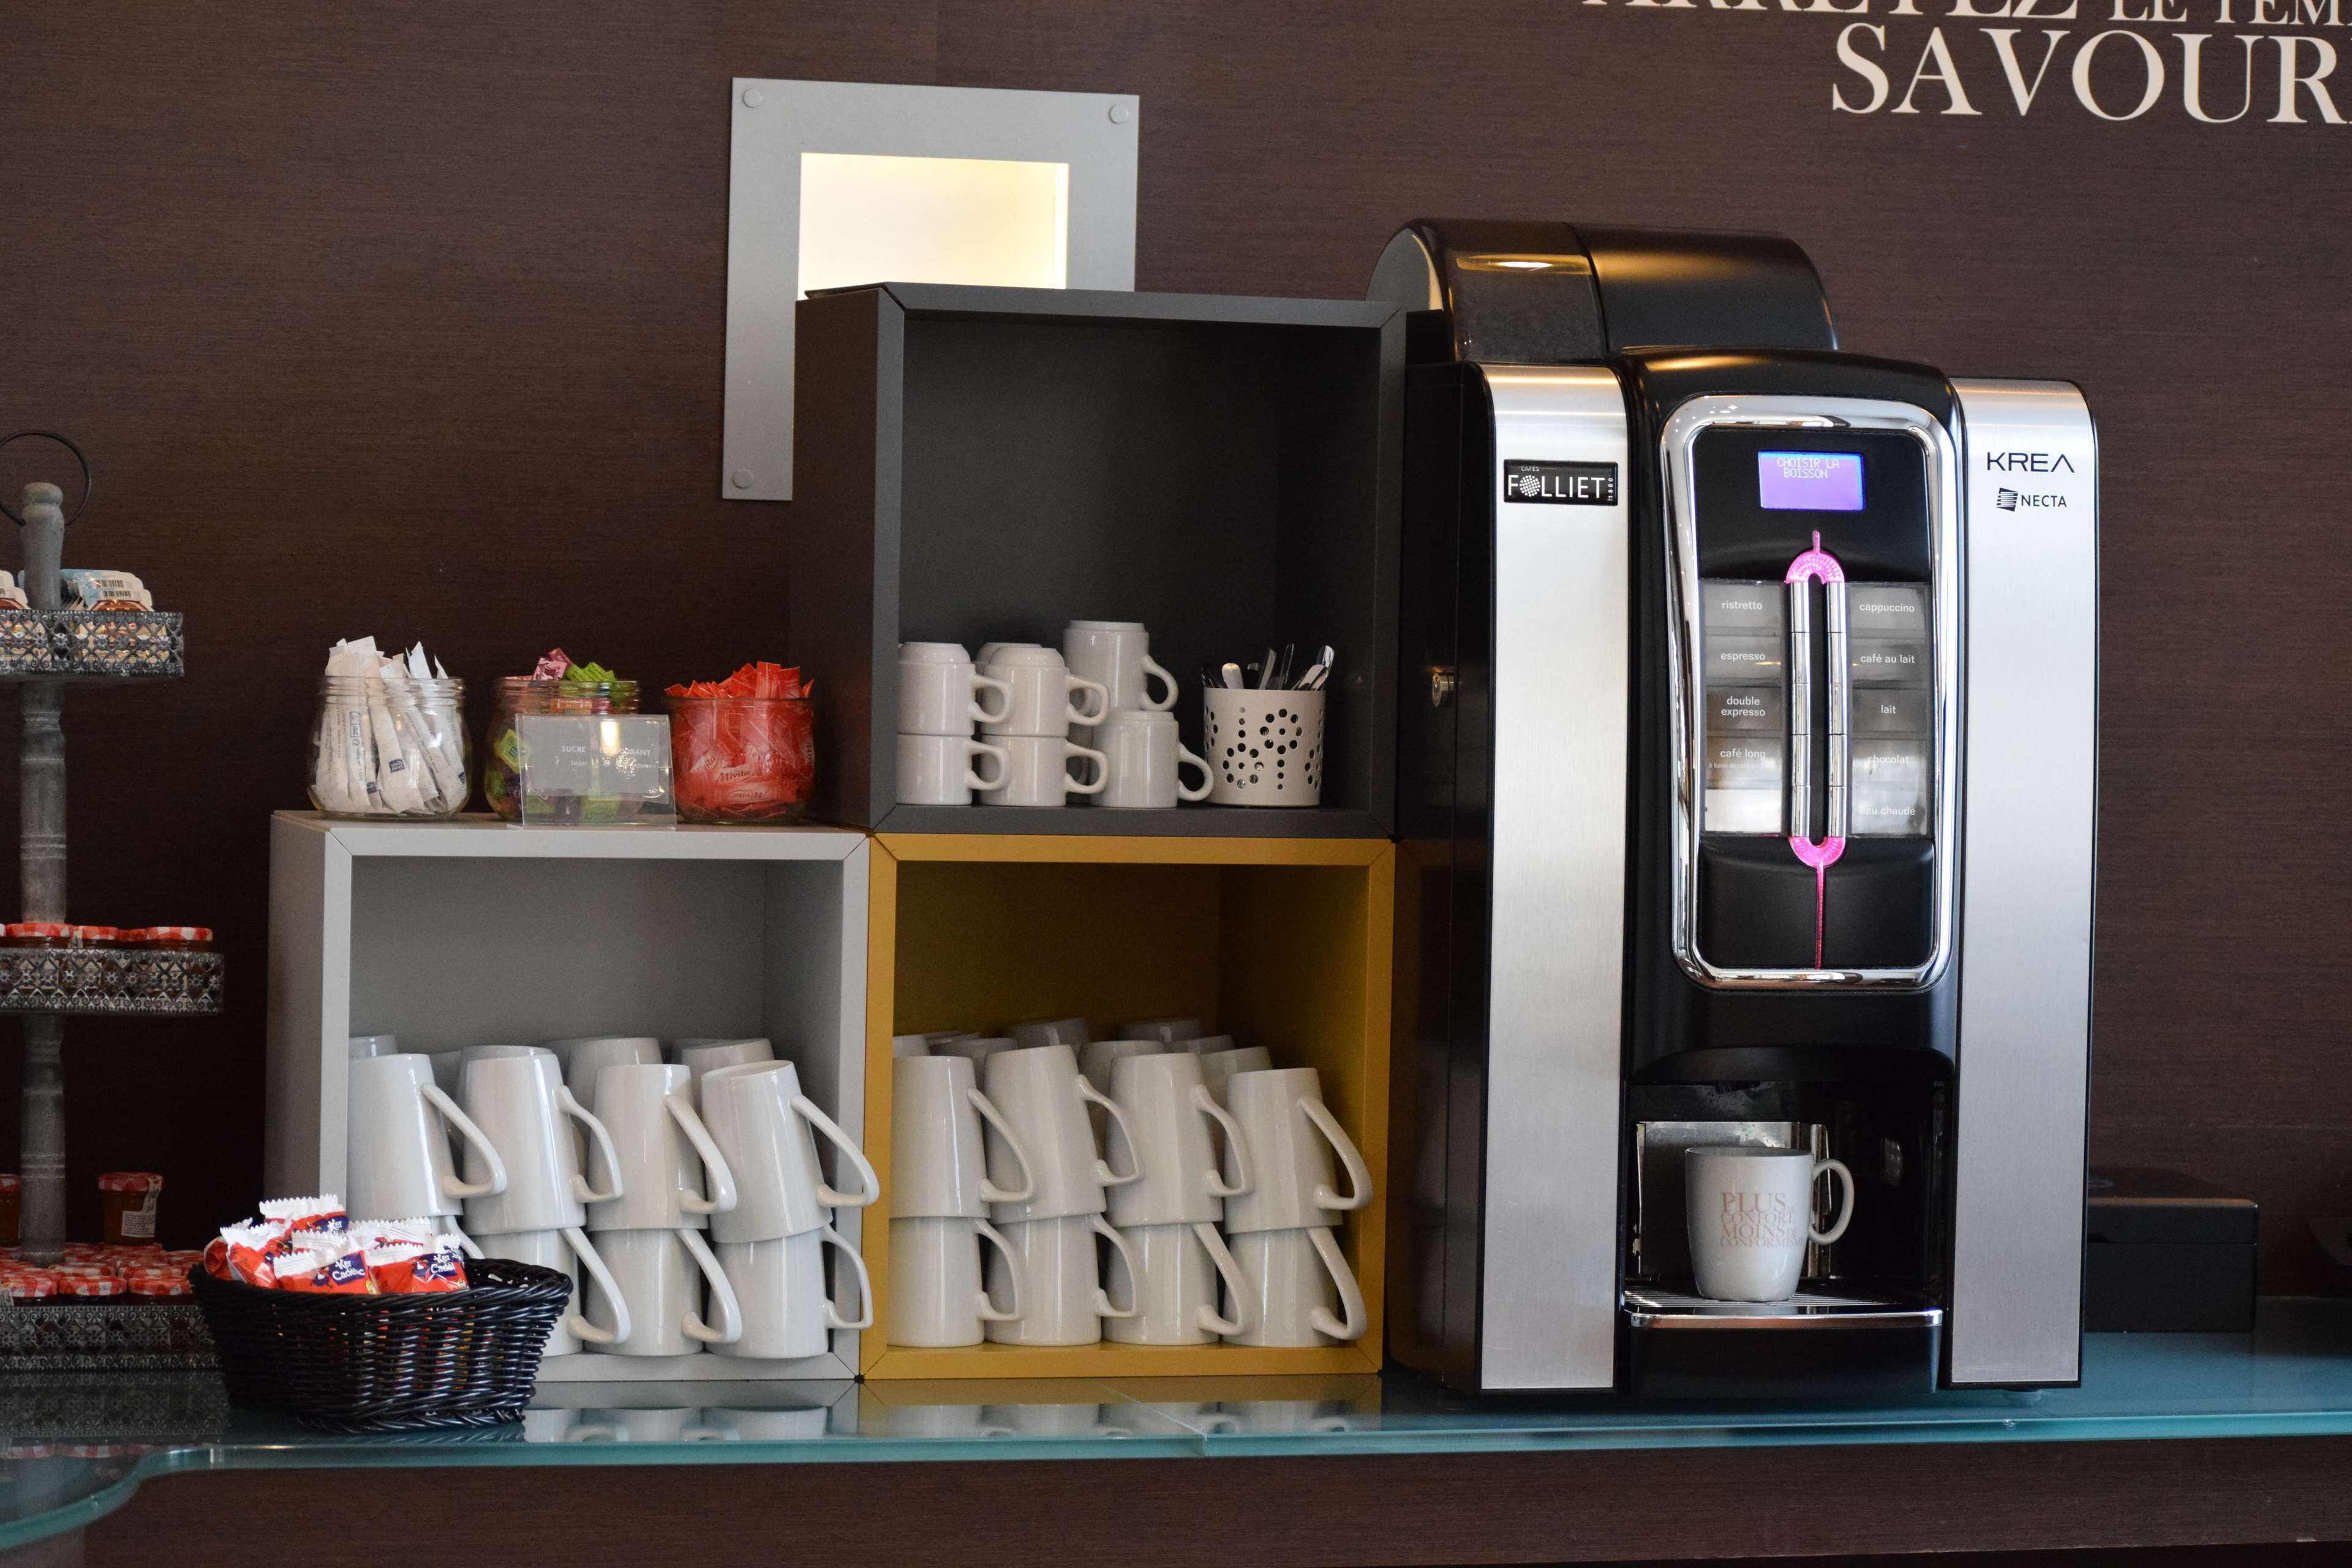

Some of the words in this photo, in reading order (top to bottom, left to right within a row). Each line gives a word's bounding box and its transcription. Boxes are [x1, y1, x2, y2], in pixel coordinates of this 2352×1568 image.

[1833, 22, 2352, 124] SAVOUR
[1777, 457, 1821, 468] CHOISIR
[1826, 459, 1839, 469] LA
[1987, 451, 2075, 473] KREA
[1784, 467, 1828, 478] BOISSON
[1508, 474, 1605, 499] FOLLIET
[2021, 494, 2067, 507] NECTA
[1722, 600, 1763, 610] ristretto
[1859, 603, 1915, 613] cappuccino
[1721, 653, 1765, 662] espresso
[1860, 653, 1882, 663] café
[1899, 654, 1916, 663] lait
[1727, 696, 1760, 706] double
[1721, 708, 1766, 717] expresso
[1880, 704, 1897, 714] lait
[1720, 748, 1742, 758] café
[1745, 748, 1766, 760] long
[1868, 754, 1910, 764] chocolat
[718, 769, 751, 782] Mivita
[1880, 806, 1917, 815] chaude
[1721, 1192, 1786, 1213] PLUS
[1721, 1224, 1785, 1238] MOINS
[334, 1259, 352, 1270] Ker
